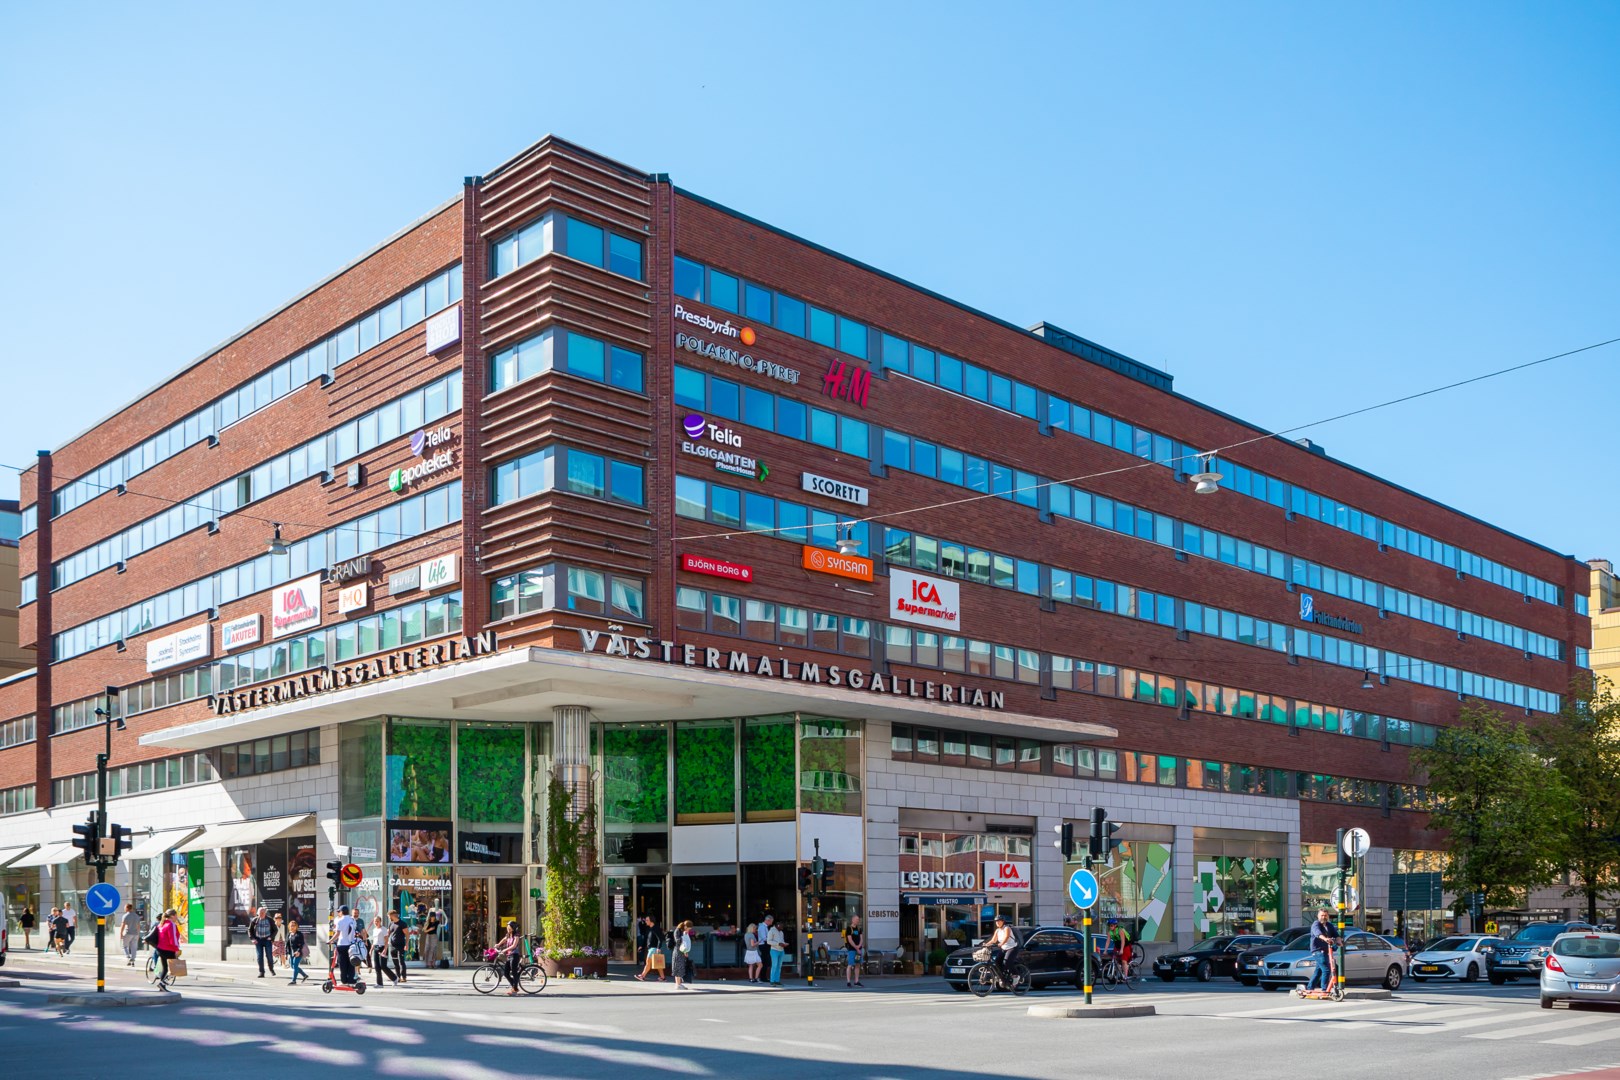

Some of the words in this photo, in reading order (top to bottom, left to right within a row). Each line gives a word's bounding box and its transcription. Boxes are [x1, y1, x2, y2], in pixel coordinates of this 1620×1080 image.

[674, 304, 737, 338] Pressbyrån
[677, 333, 739, 366] POLARN
[757, 360, 801, 384] PYRET
[823, 359, 871, 409] H&M
[425, 427, 451, 449] Telia
[707, 423, 742, 448] Telia
[401, 449, 454, 485] apoteket
[682, 442, 756, 470] ELGIGANTEN
[812, 477, 860, 502] SCORETT
[327, 555, 369, 583] GRANIT
[428, 559, 447, 584] life
[687, 558, 716, 572] BJÖRN
[717, 564, 739, 576] BORG
[827, 556, 868, 576] SYNSAM
[283, 589, 304, 612] ICA
[912, 579, 942, 606] ICA
[274, 605, 317, 628] Supermarket
[897, 598, 957, 622] Supermarket
[231, 627, 256, 643] AKUTEN
[211, 630, 494, 714] VÄSTERMALMSGALLERIAN
[577, 625, 1006, 709] VÄSTERMALMSGALLERIAN
[139, 864, 149, 879] 48
[389, 878, 452, 887] CALZEDONIA
[999, 863, 1020, 879] ICA
[988, 878, 1030, 890] Supermarket
